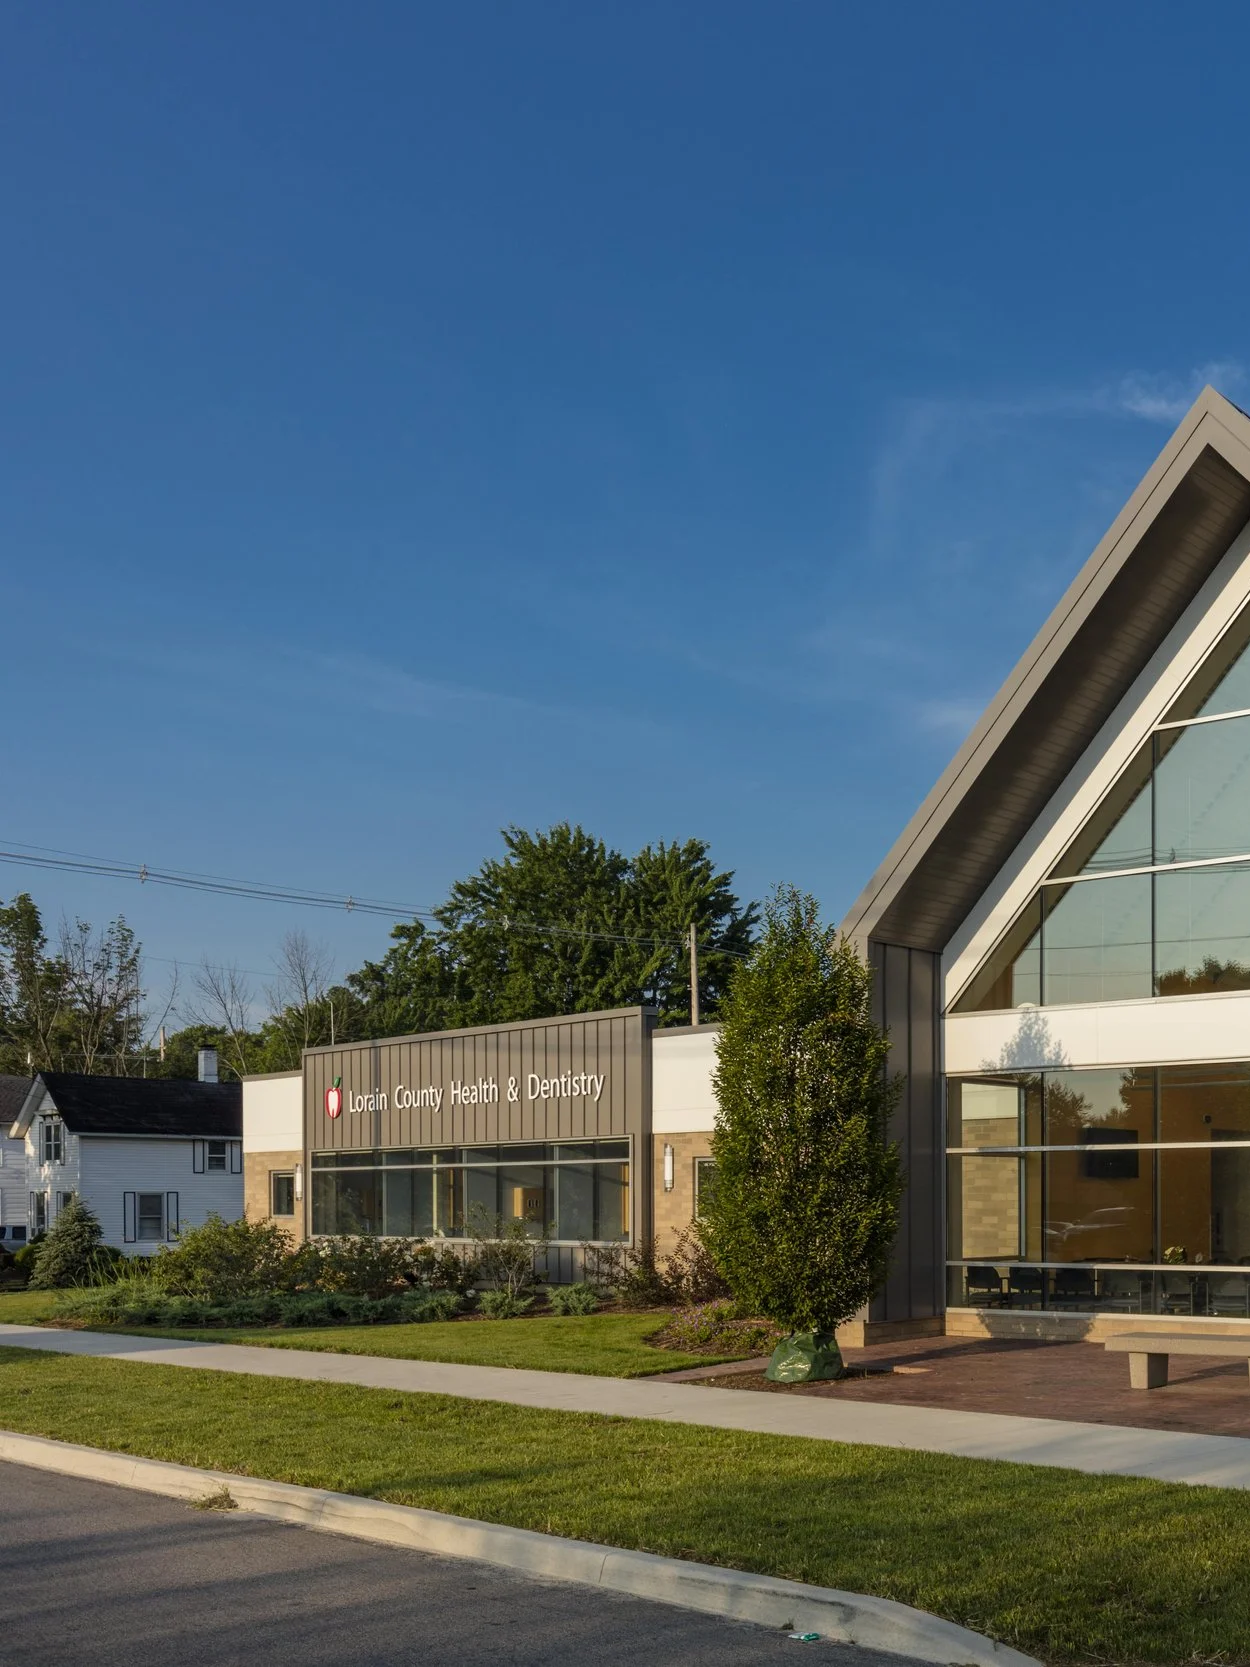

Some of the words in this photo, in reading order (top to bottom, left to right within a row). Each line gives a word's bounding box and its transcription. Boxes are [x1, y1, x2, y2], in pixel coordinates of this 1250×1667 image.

[349, 1088, 388, 1113] Lorain
[394, 1085, 443, 1112] County
[451, 1077, 499, 1105] Health
[507, 1076, 520, 1102] &
[528, 1070, 605, 1102] Dentistry
